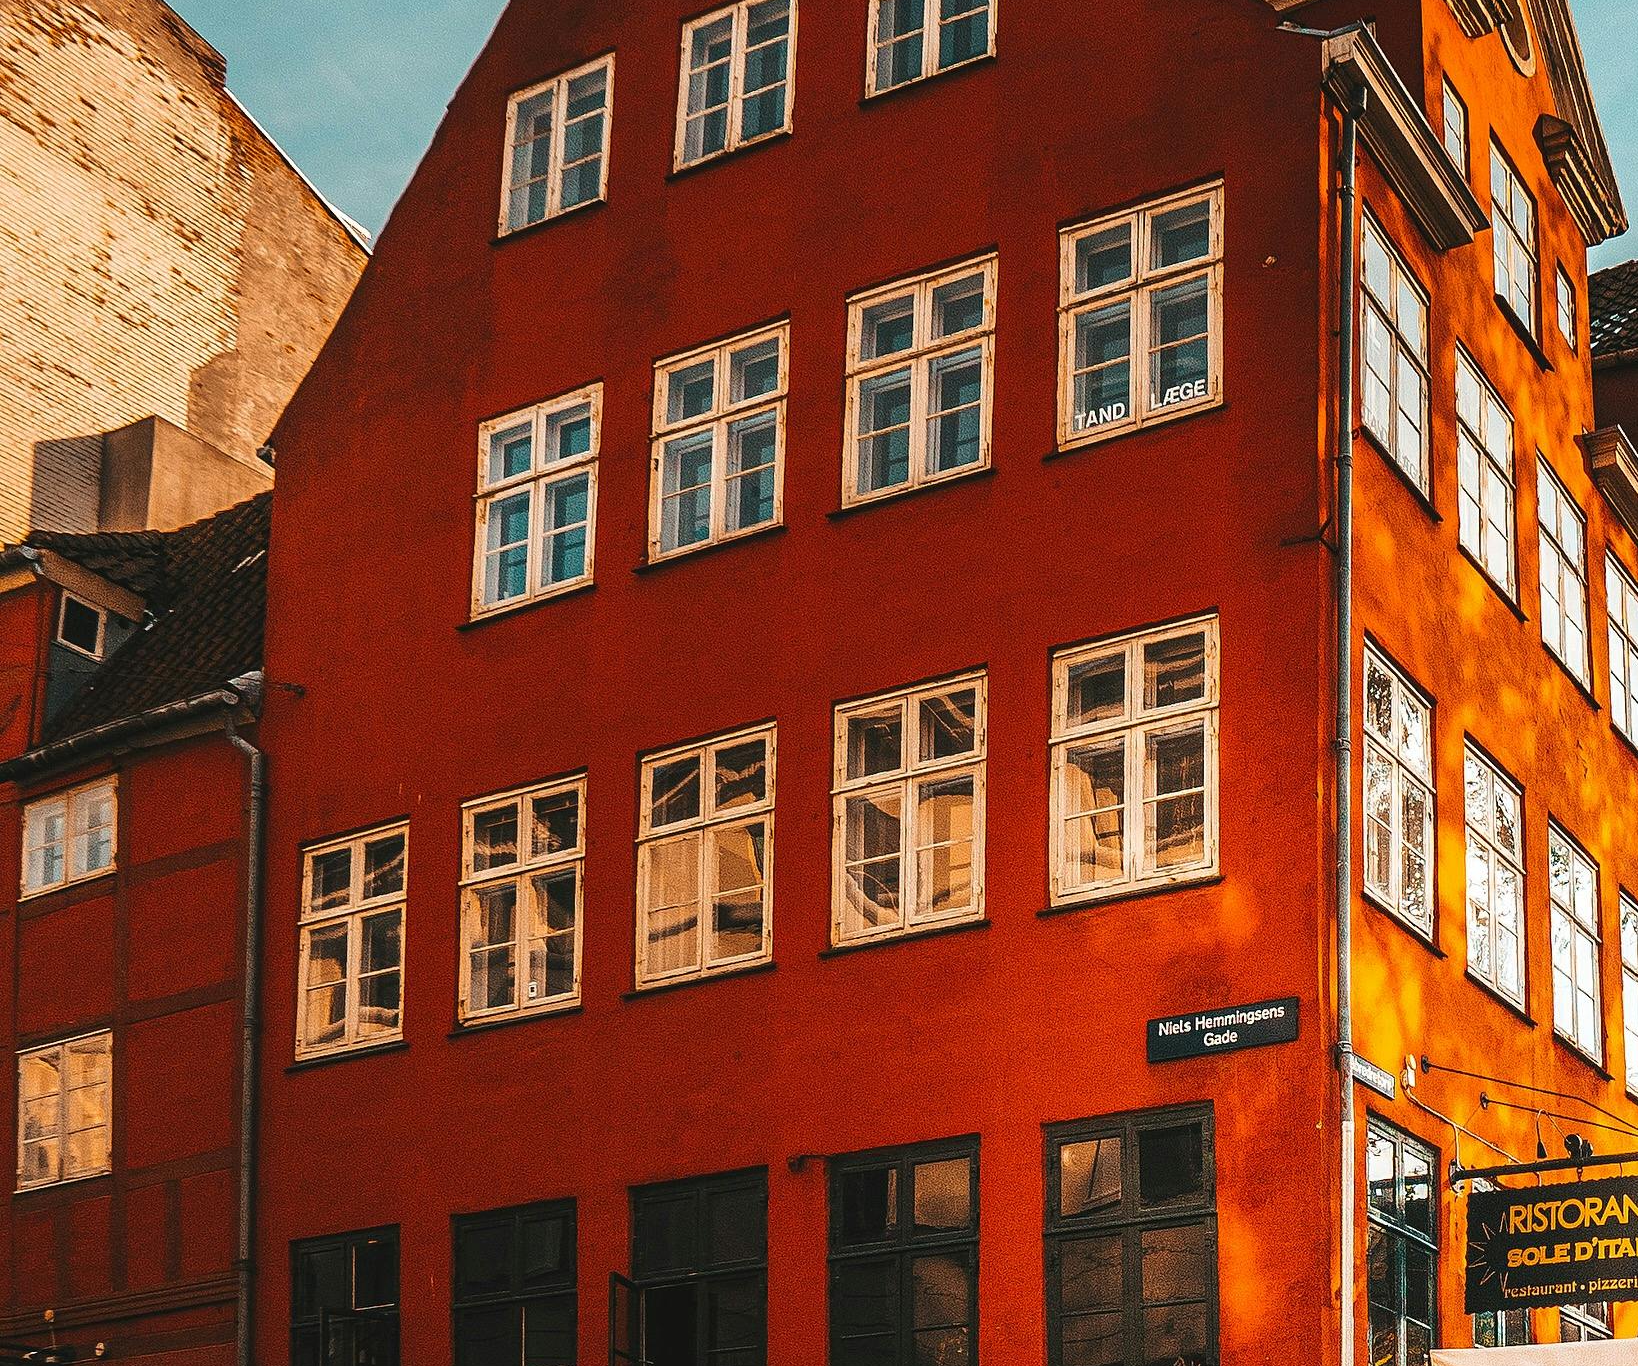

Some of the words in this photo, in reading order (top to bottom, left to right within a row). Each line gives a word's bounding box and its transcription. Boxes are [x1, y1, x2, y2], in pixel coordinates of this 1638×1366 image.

[1075, 402, 1126, 431] TAND
[1151, 379, 1206, 409] LÆGE
[1158, 1019, 1192, 1037] Niels
[1195, 1006, 1285, 1031] Hemmingsens
[1203, 1030, 1238, 1047] Gade
[1507, 1242, 1571, 1268] SOLE
[1504, 1280, 1577, 1299] restaurant
